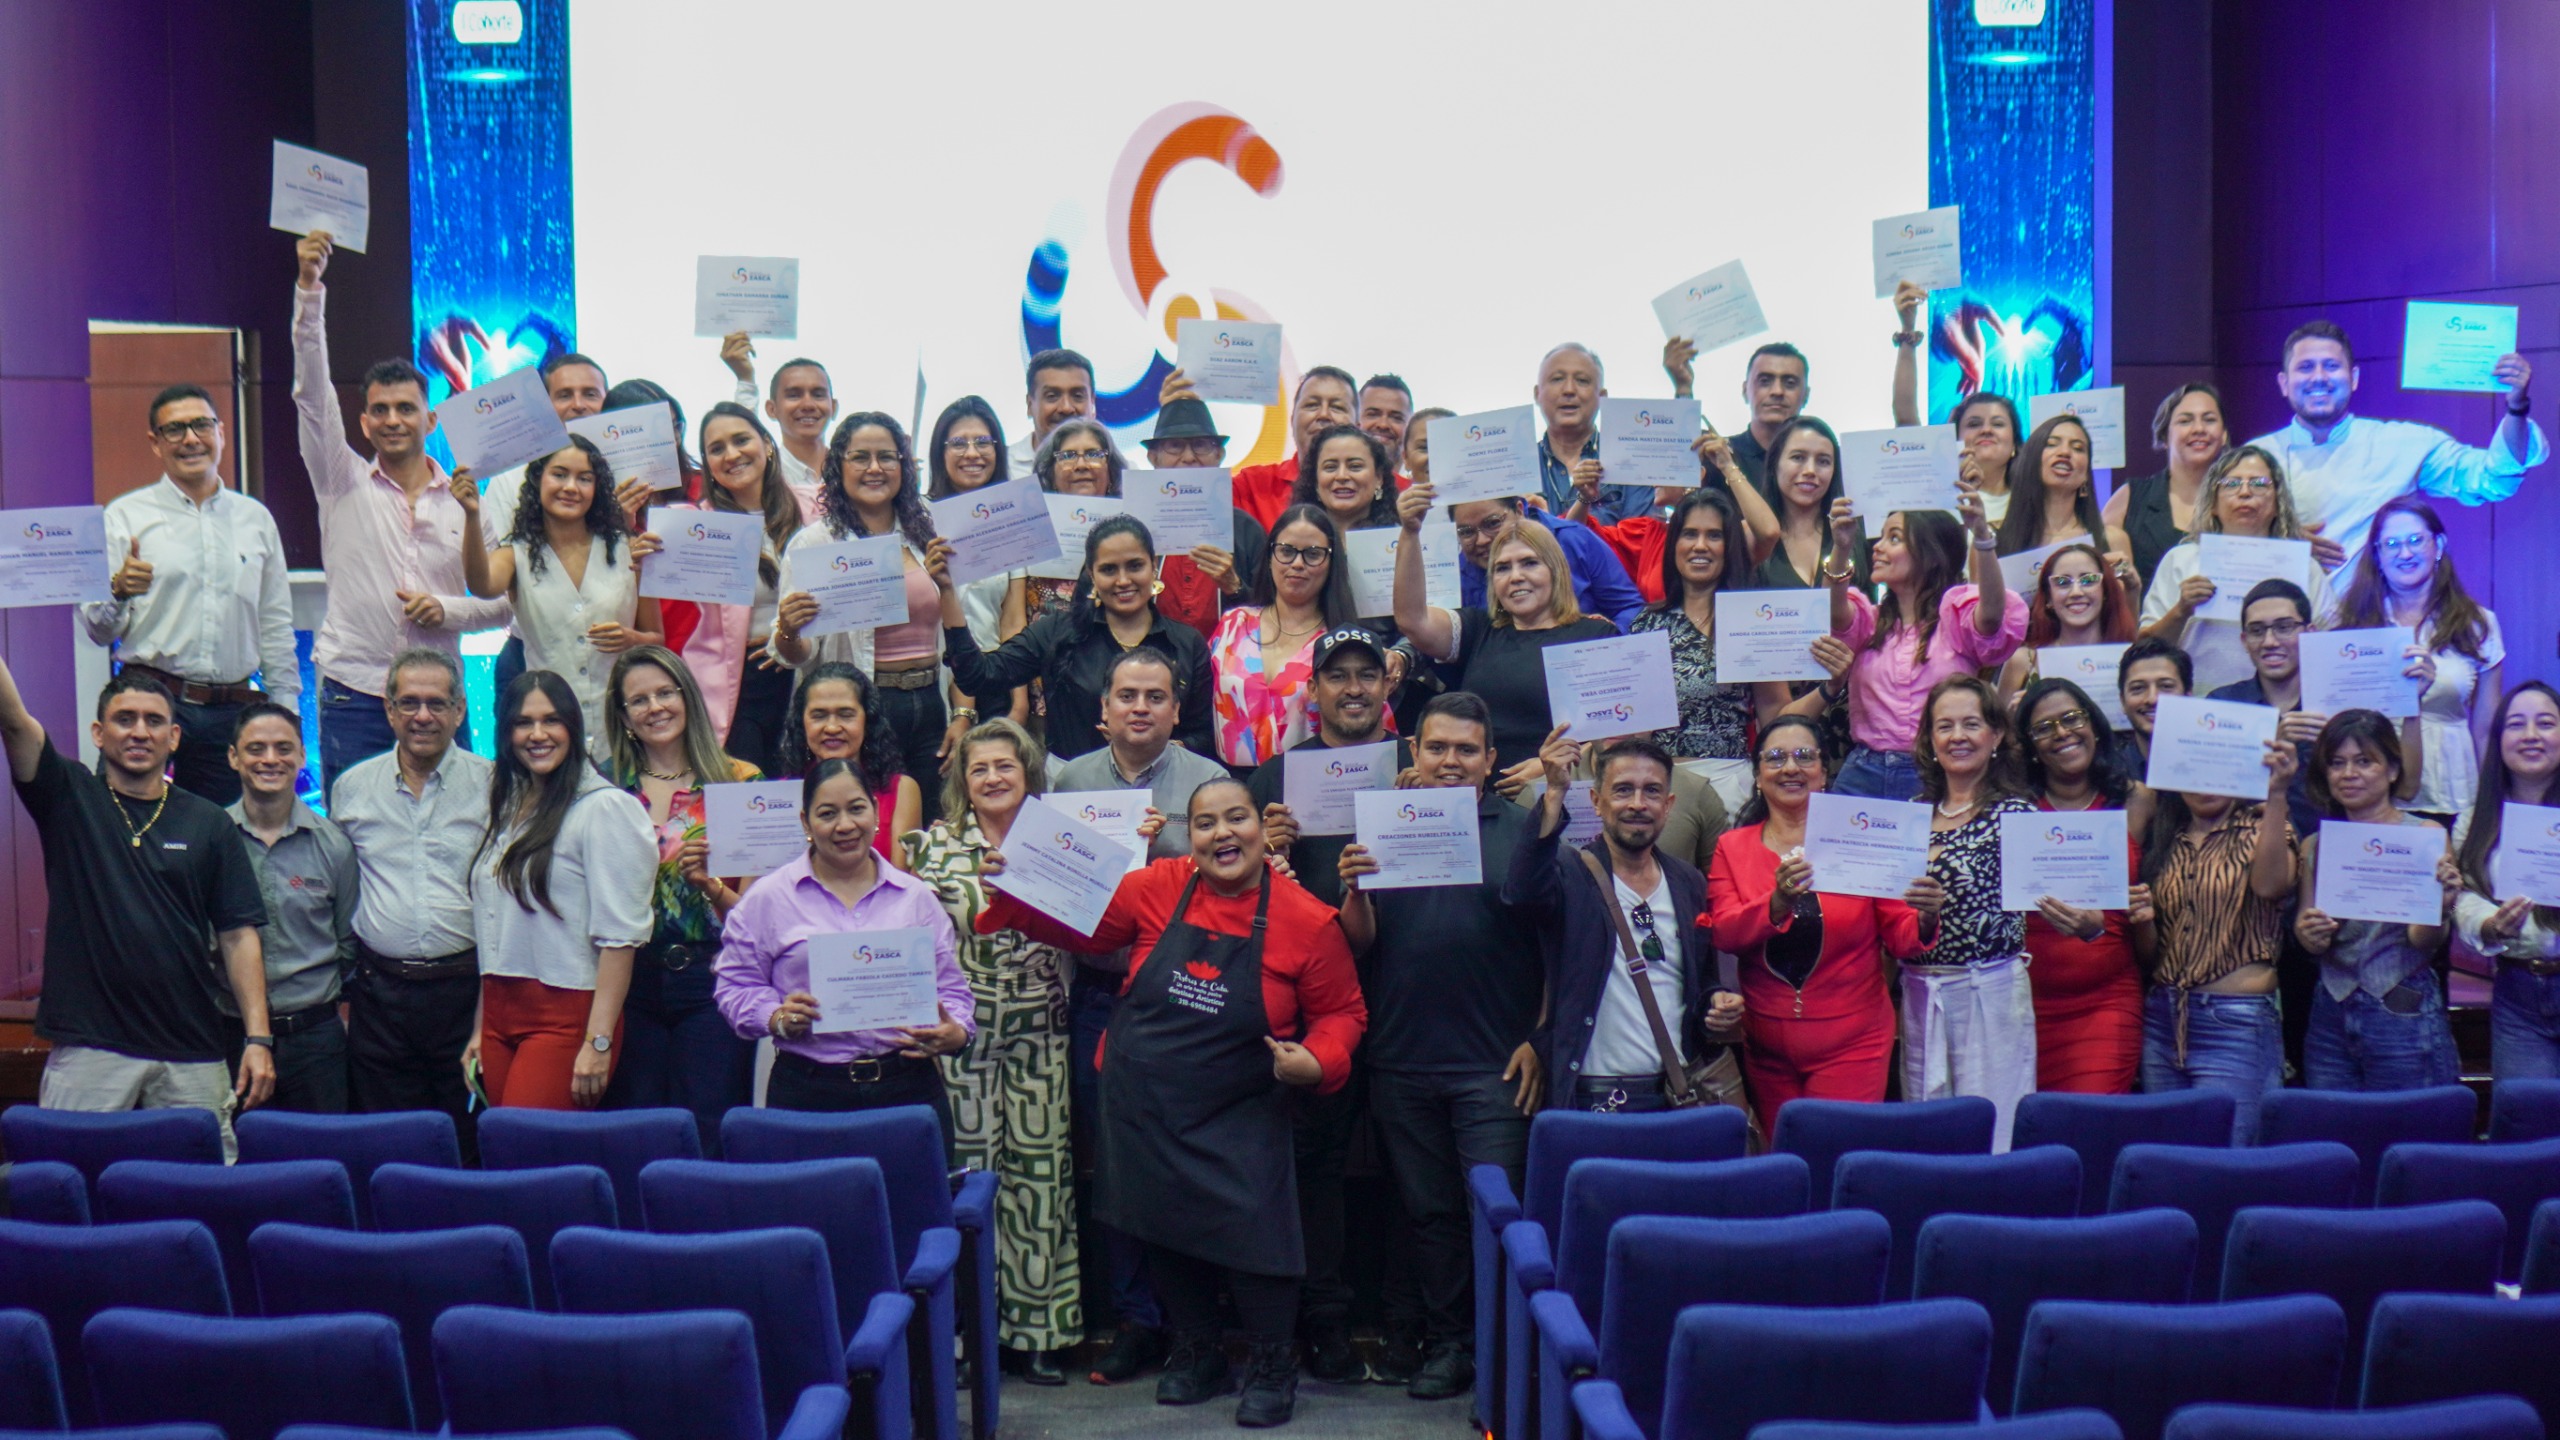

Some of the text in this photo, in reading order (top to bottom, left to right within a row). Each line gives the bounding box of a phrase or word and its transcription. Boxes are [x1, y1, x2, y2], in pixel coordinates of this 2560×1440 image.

[493, 395, 516, 409] ZASCA
[621, 427, 643, 436] ZASCA
[1483, 429, 1506, 437] ZASCA
[991, 503, 1015, 513] ZASCA
[707, 533, 731, 541] ZASCA
[950, 533, 974, 544] JENNIFER
[975, 524, 1005, 537] ALEXANDRA
[830, 581, 855, 589] JOHANNA
[1324, 630, 1372, 650] BOSS
[1598, 685, 1631, 694] MAURICIO
[2218, 722, 2242, 730] ZASCA
[1345, 766, 1368, 774] ZASCA
[1871, 822, 1897, 830] ZASCA
[1072, 845, 1096, 862] ZASCA
[1040, 851, 1066, 867] CATALINA
[1066, 865, 1089, 879] BONILLA
[1088, 877, 1112, 892] MURILLO
[1168, 986, 1194, 999] Gelatinas
